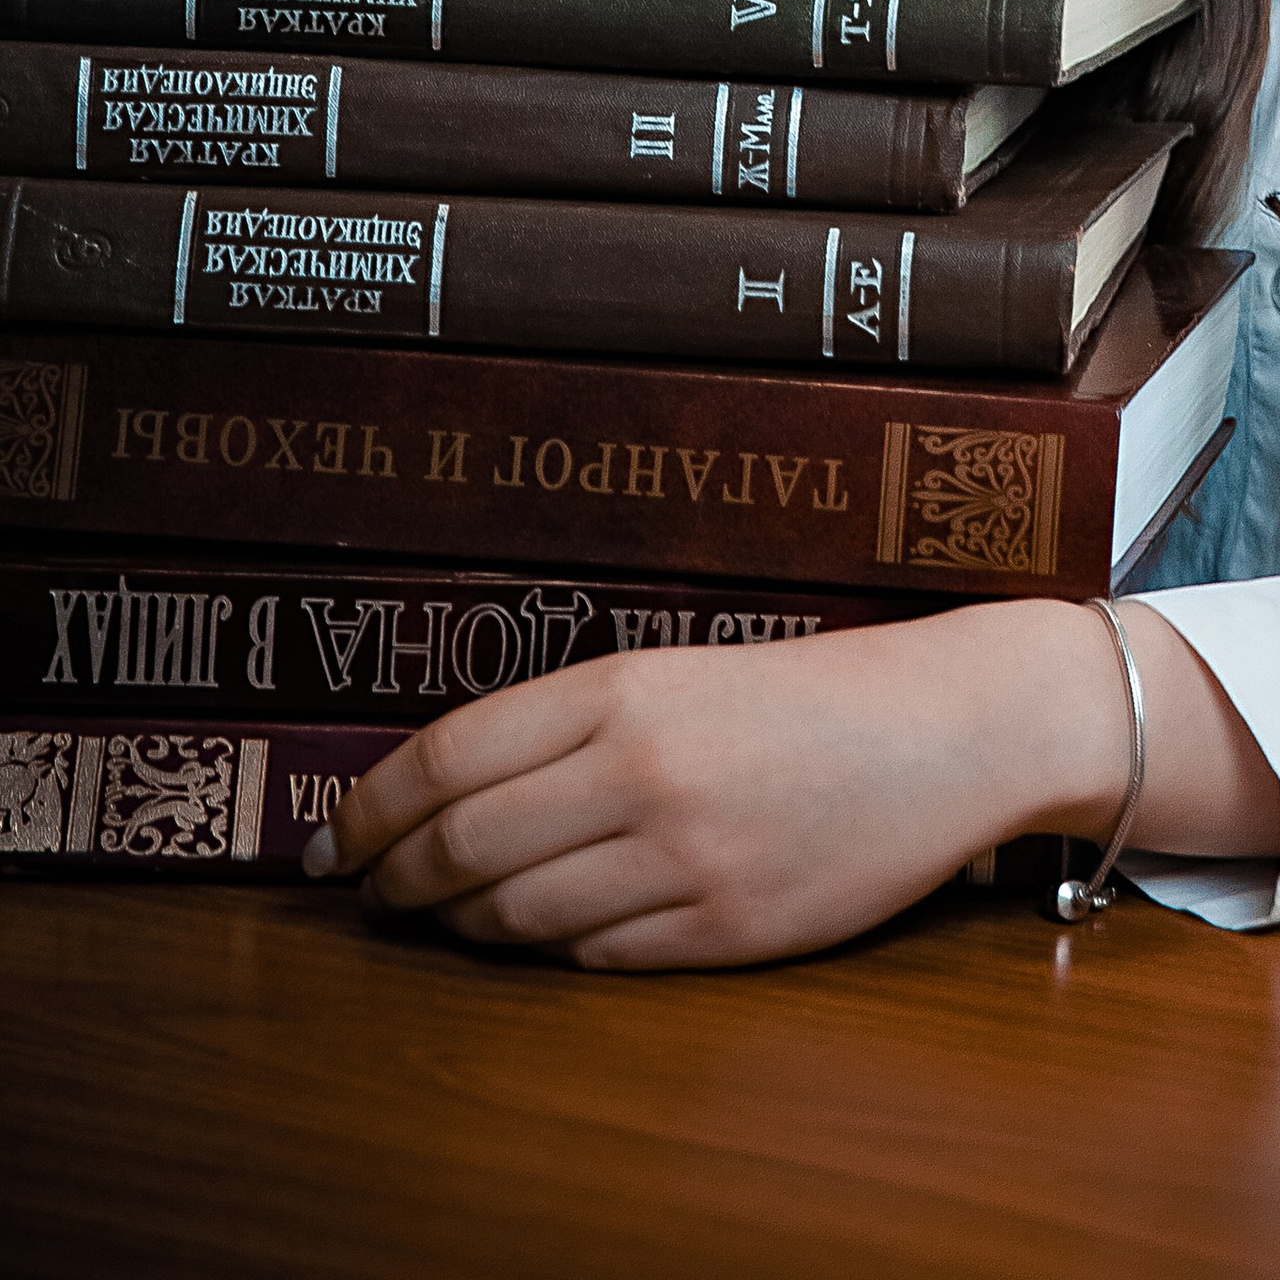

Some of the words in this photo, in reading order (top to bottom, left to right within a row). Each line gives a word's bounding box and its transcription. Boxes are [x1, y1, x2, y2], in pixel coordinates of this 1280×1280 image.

[238, 7, 386, 37] КРАТКАЯ
[101, 64, 318, 100] ЭНЦИКЛОПЕДИЯ
[102, 100, 317, 137] ХИМИЧЕСКАЯ
[130, 139, 281, 168] КРАТКАЯ
[205, 207, 423, 248] ЭНЦИКЛОПЕДИЯ
[203, 243, 422, 284] ХИМИЧЕСКАЯ
[228, 282, 383, 313] КРАТКАЯ
[110, 407, 398, 479] ЧЕХОВЫ
[424, 429, 471, 484] И
[493, 435, 849, 511] ТАГАНРОГ
[41, 574, 234, 689] ЛИЦАХ
[246, 595, 280, 690] В
[301, 587, 598, 696] ДОНА
